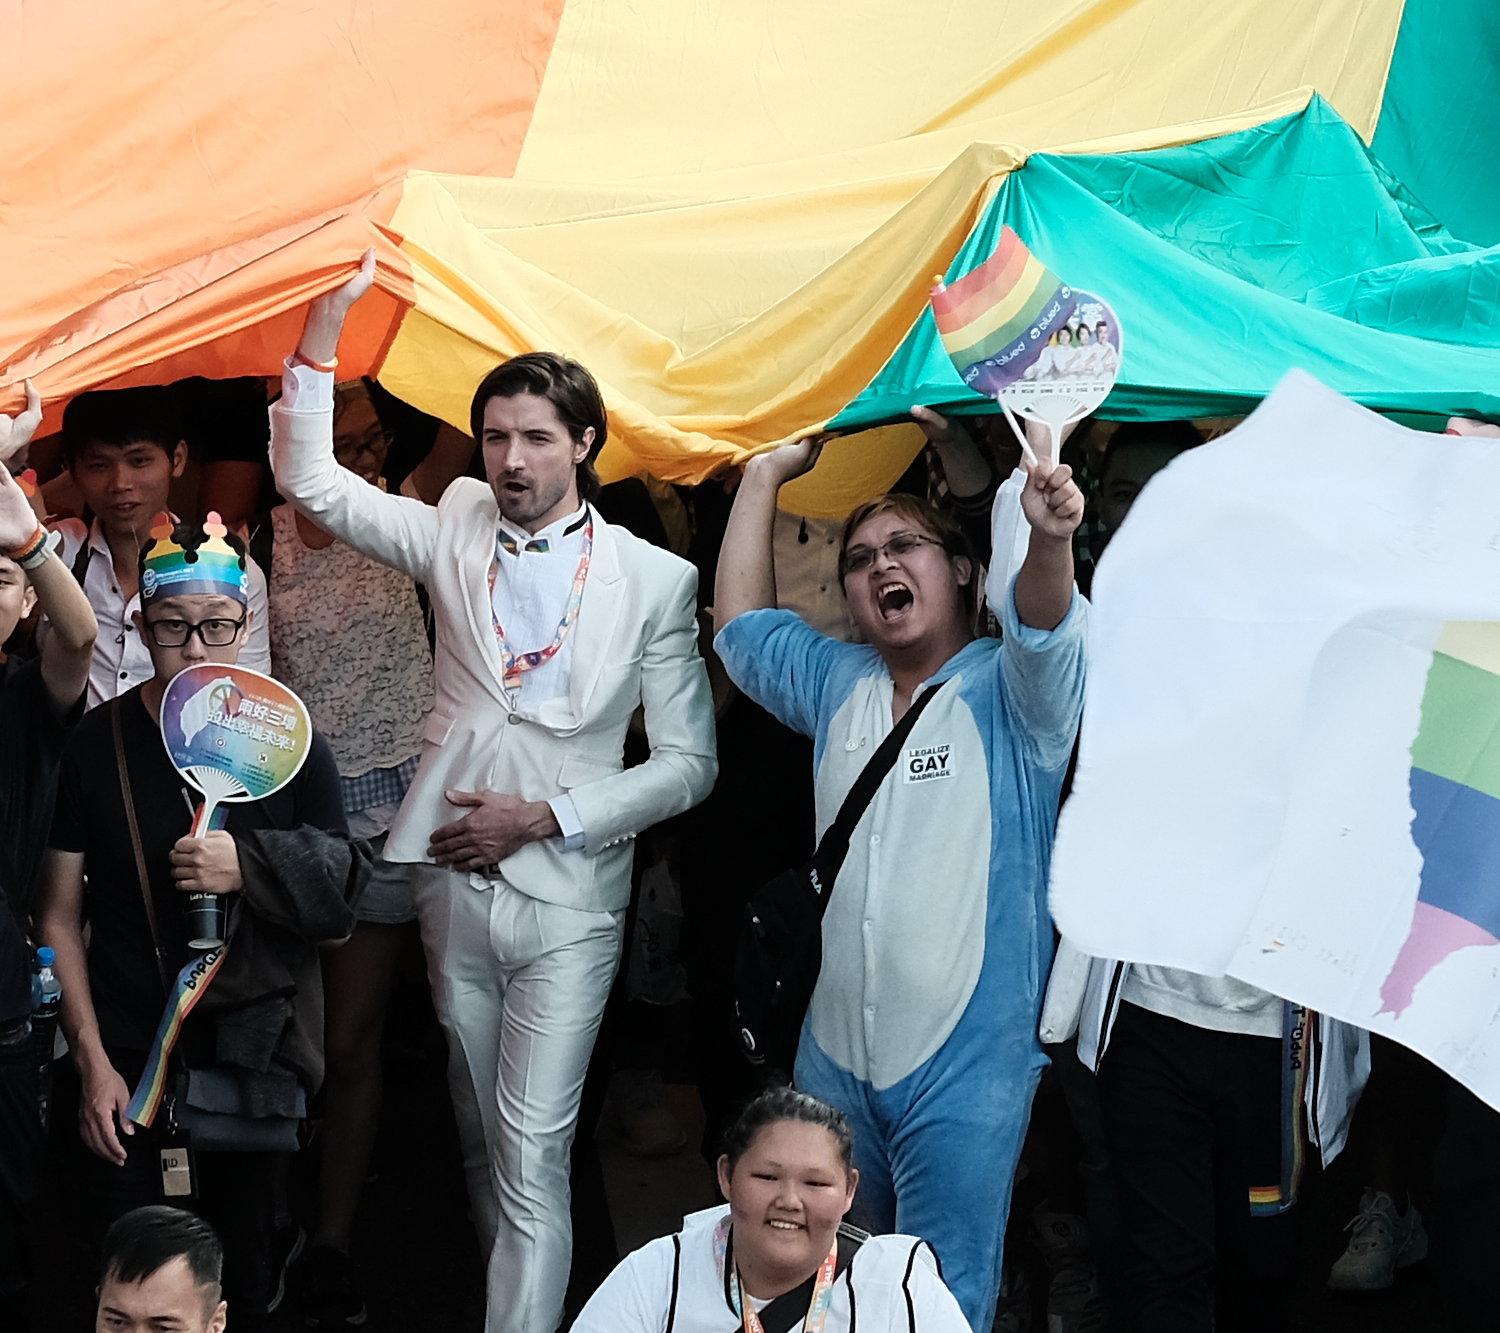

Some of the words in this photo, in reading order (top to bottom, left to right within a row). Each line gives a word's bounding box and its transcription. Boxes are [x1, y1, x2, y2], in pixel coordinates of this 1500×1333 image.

[994, 341, 1026, 367] blued
[1038, 300, 1061, 332] blued
[909, 744, 951, 758] LEGALIZE
[909, 753, 950, 774] GAY
